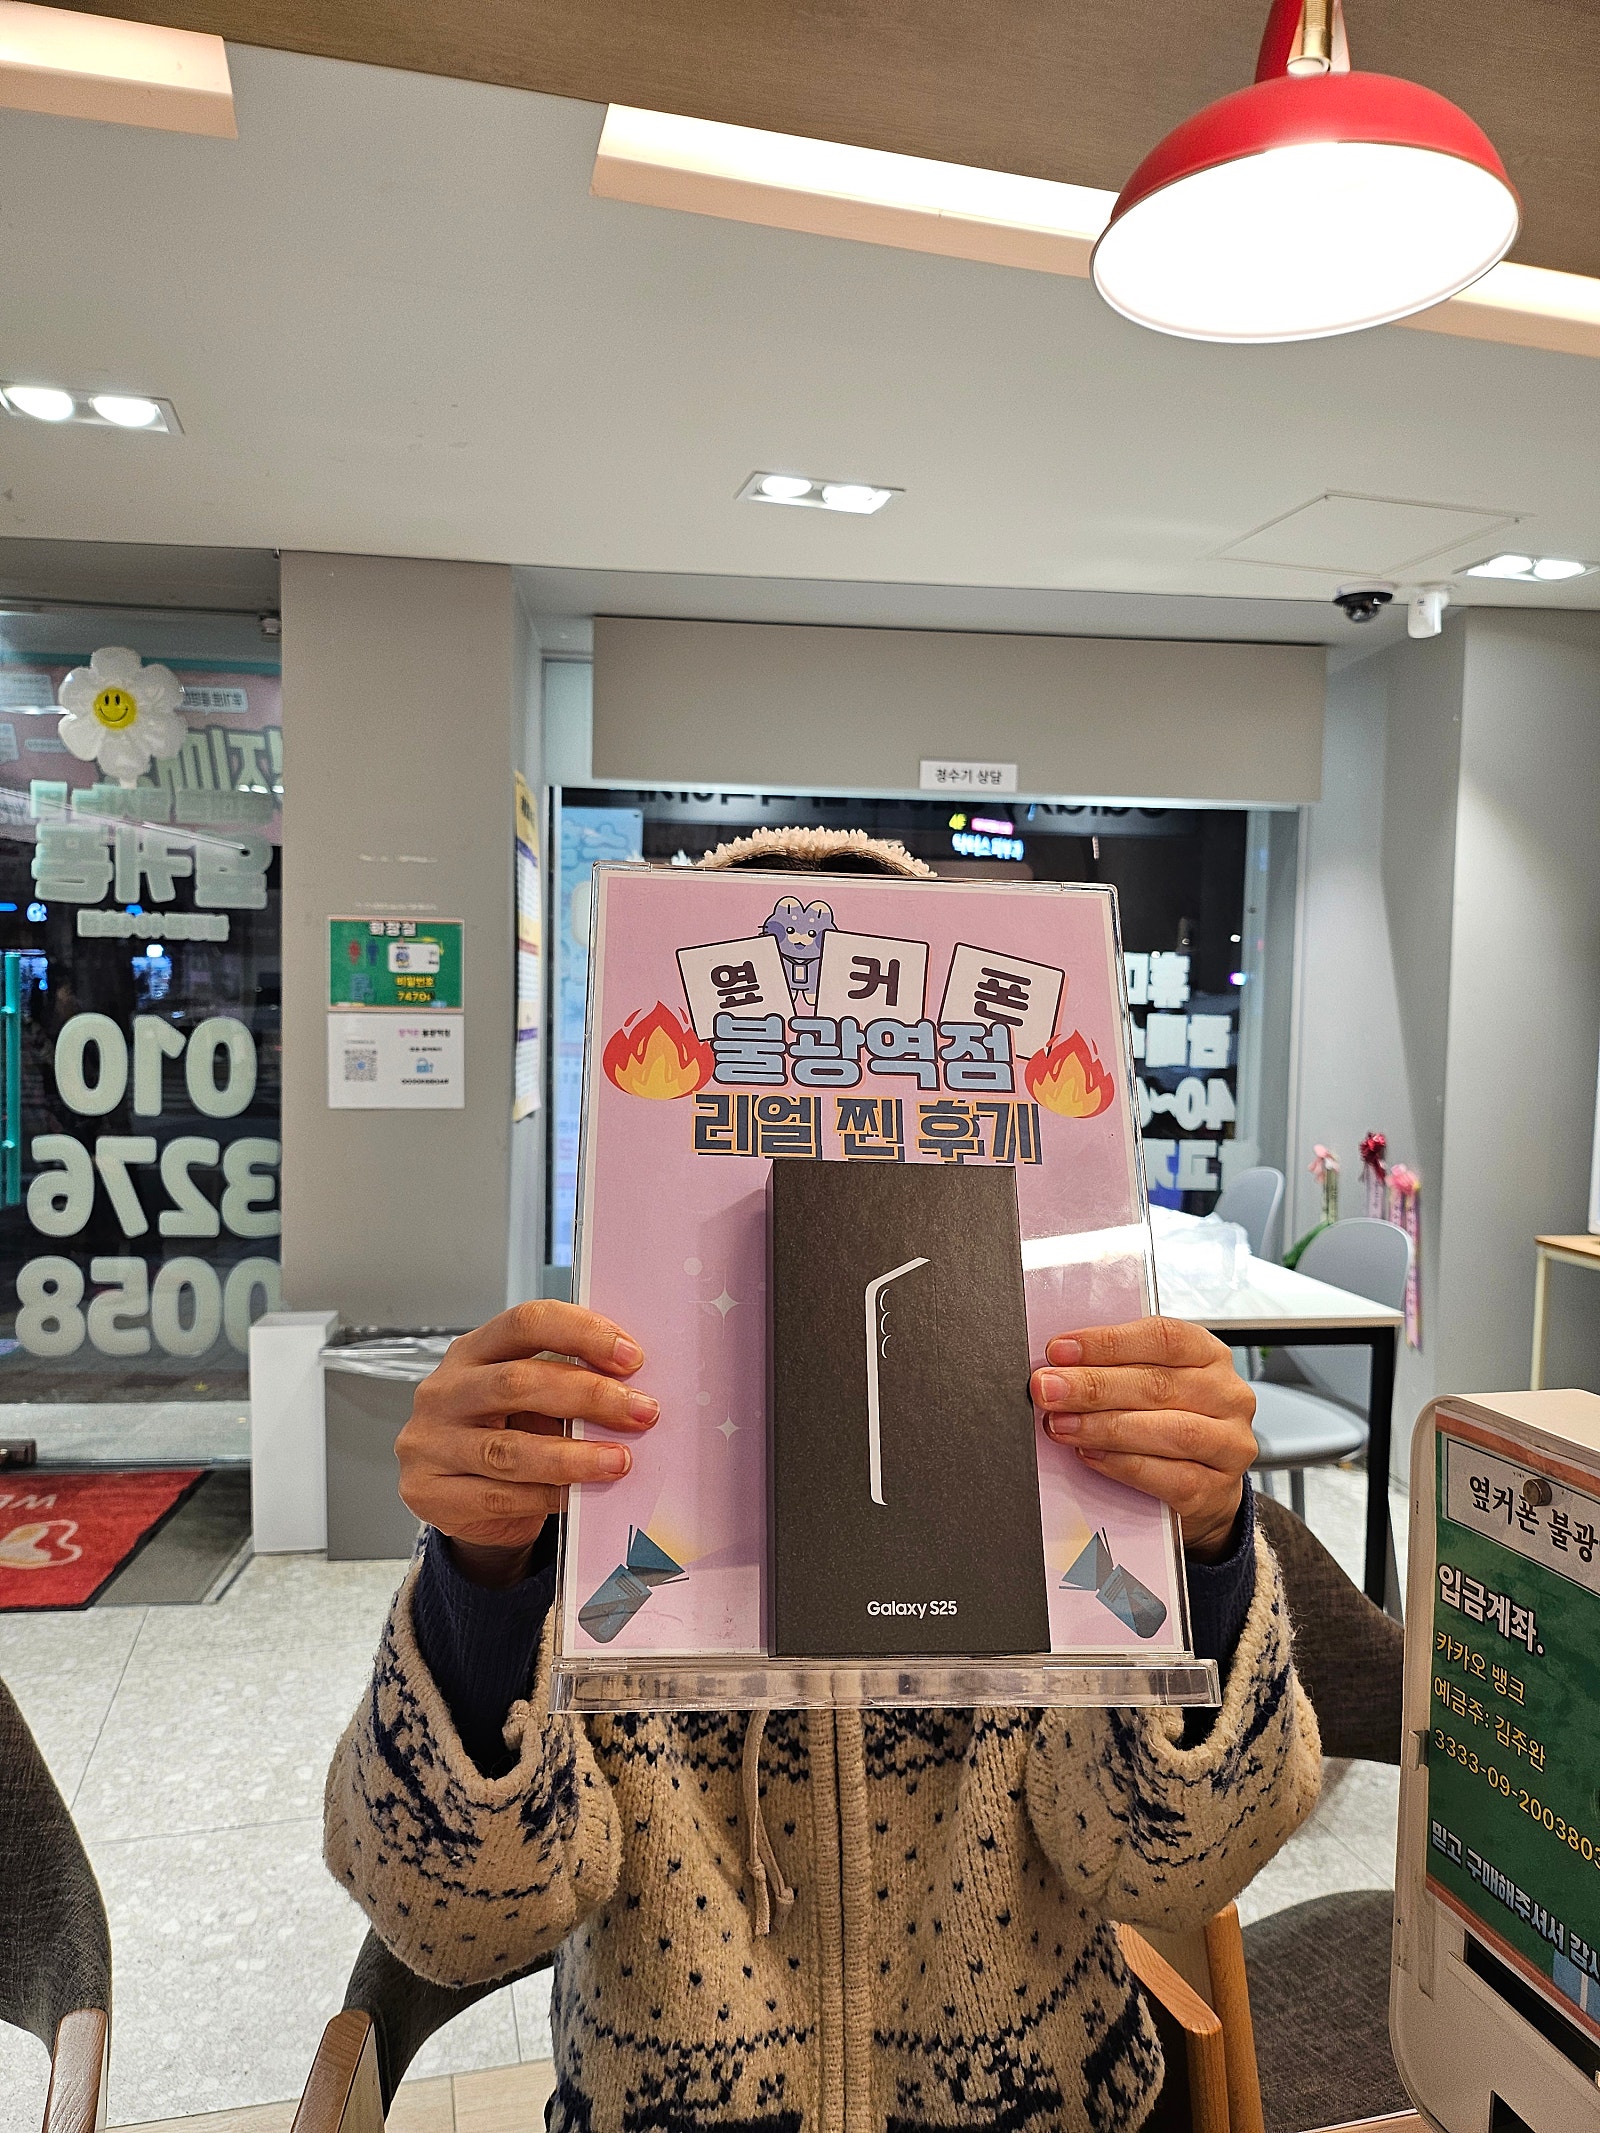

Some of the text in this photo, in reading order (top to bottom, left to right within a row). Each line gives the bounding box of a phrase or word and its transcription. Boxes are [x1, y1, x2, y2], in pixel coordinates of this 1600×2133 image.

[978, 770, 1002, 785] 상담
[710, 955, 1033, 1027] 옆 커 폰
[711, 1012, 1016, 1092] 불광역점
[692, 1093, 1043, 1164] 리얼 찐 후기
[867, 1600, 958, 1619] Galaxy S25
[1437, 1564, 1546, 1656] 입금계좌.
[1436, 1631, 1526, 1706] 카카오 뱅크
[1433, 1676, 1546, 1774] 예금주: 김주완
[1432, 1820, 1462, 1868] 믿고
[1466, 1850, 1566, 1955] 구매해주셔서
